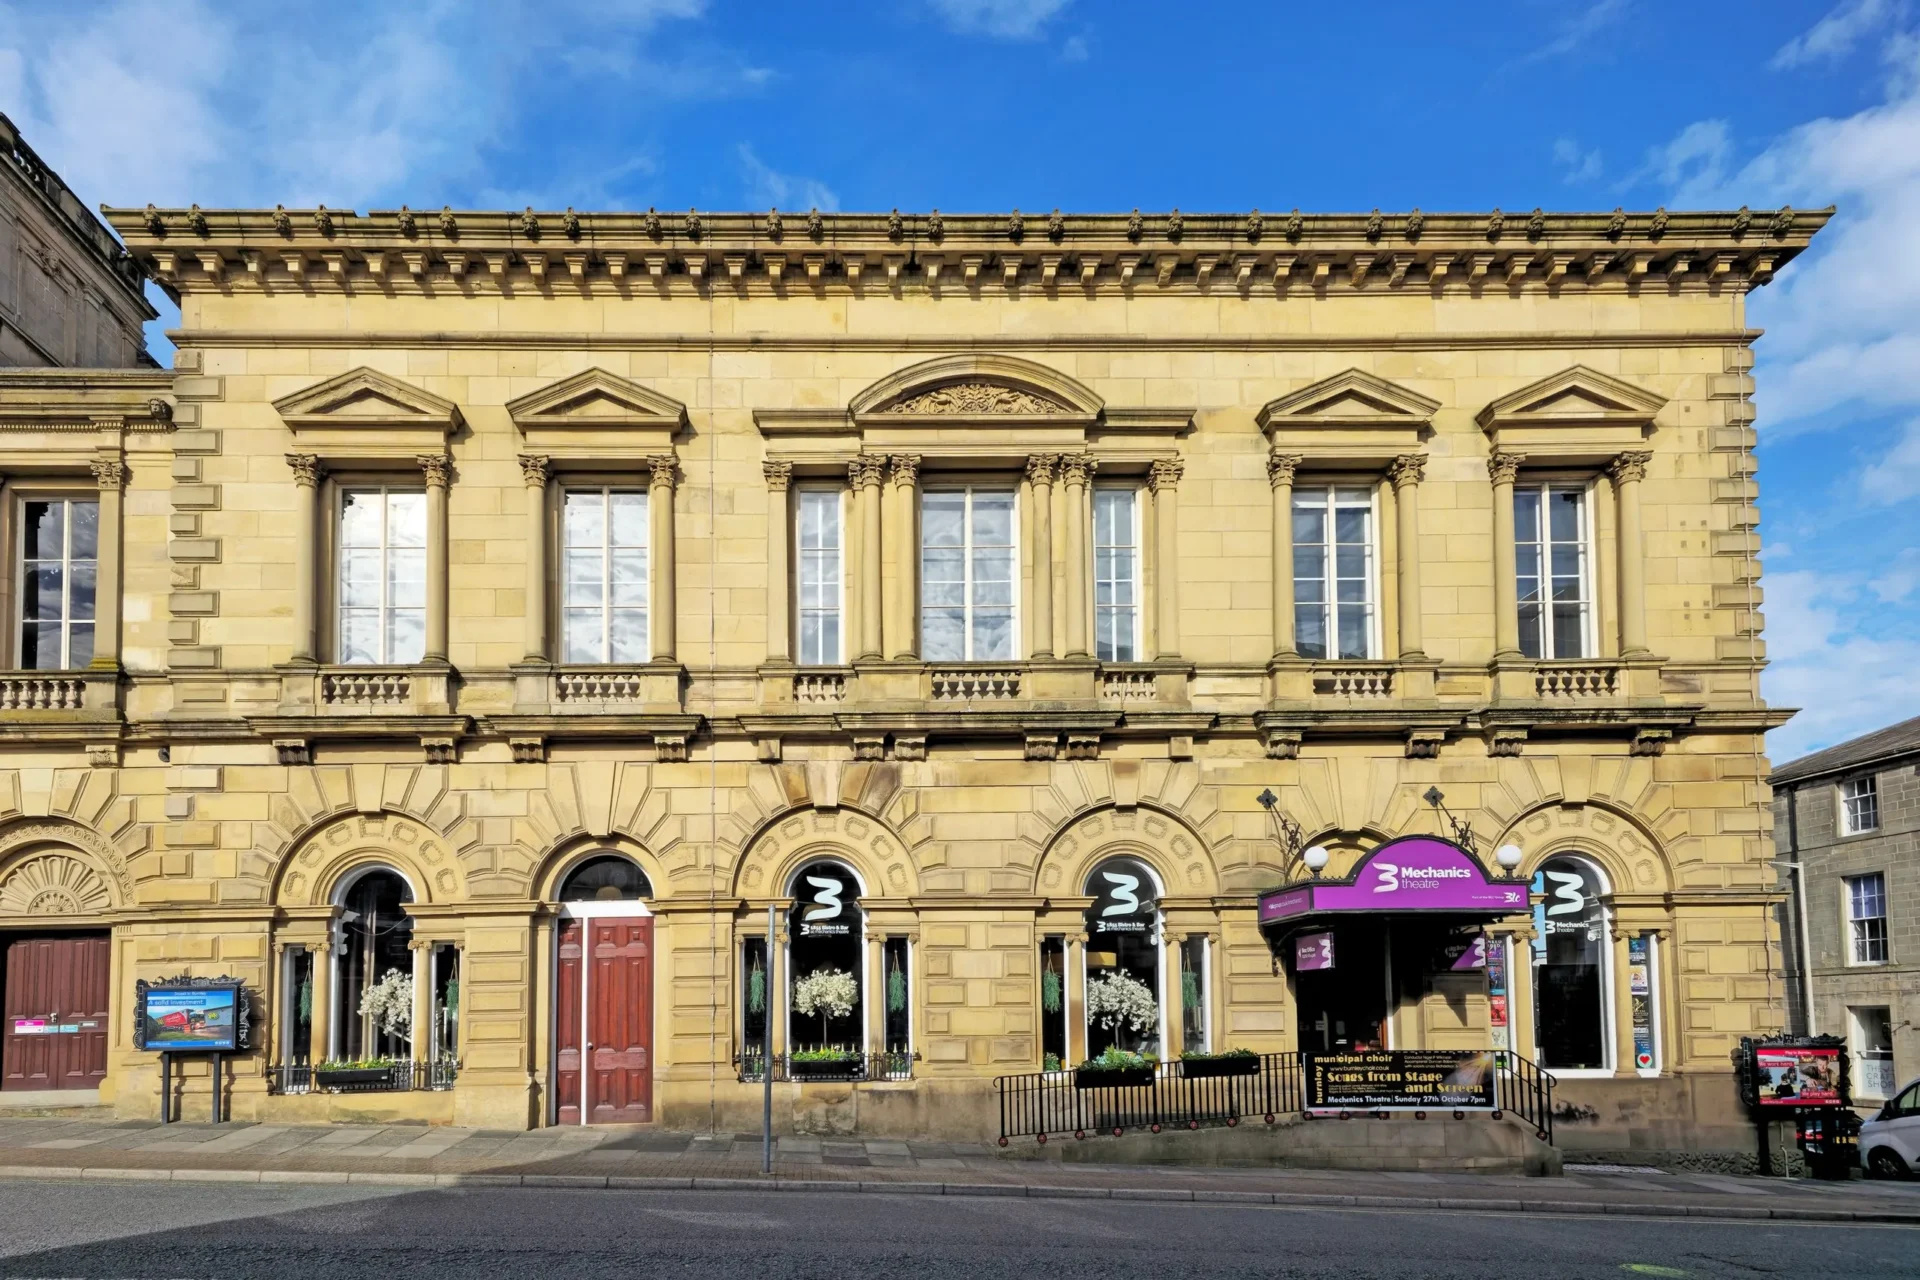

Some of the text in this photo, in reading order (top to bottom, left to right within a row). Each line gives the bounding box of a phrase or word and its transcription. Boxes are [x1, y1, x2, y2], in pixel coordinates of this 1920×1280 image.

[1402, 866, 1471, 879] Mechanics
[1402, 878, 1439, 889] theatre
[1314, 1054, 1393, 1064] municipal choir
[1866, 1064, 1882, 1072] THE
[1327, 1072, 1443, 1082] Songs from Stage
[1314, 1066, 1324, 1104] burnley
[1404, 1082, 1484, 1093] and Screen
[1868, 1080, 1894, 1088] SHOP
[1394, 1095, 1421, 1104] Sunday
[1470, 1096, 1486, 1104] 7pm
